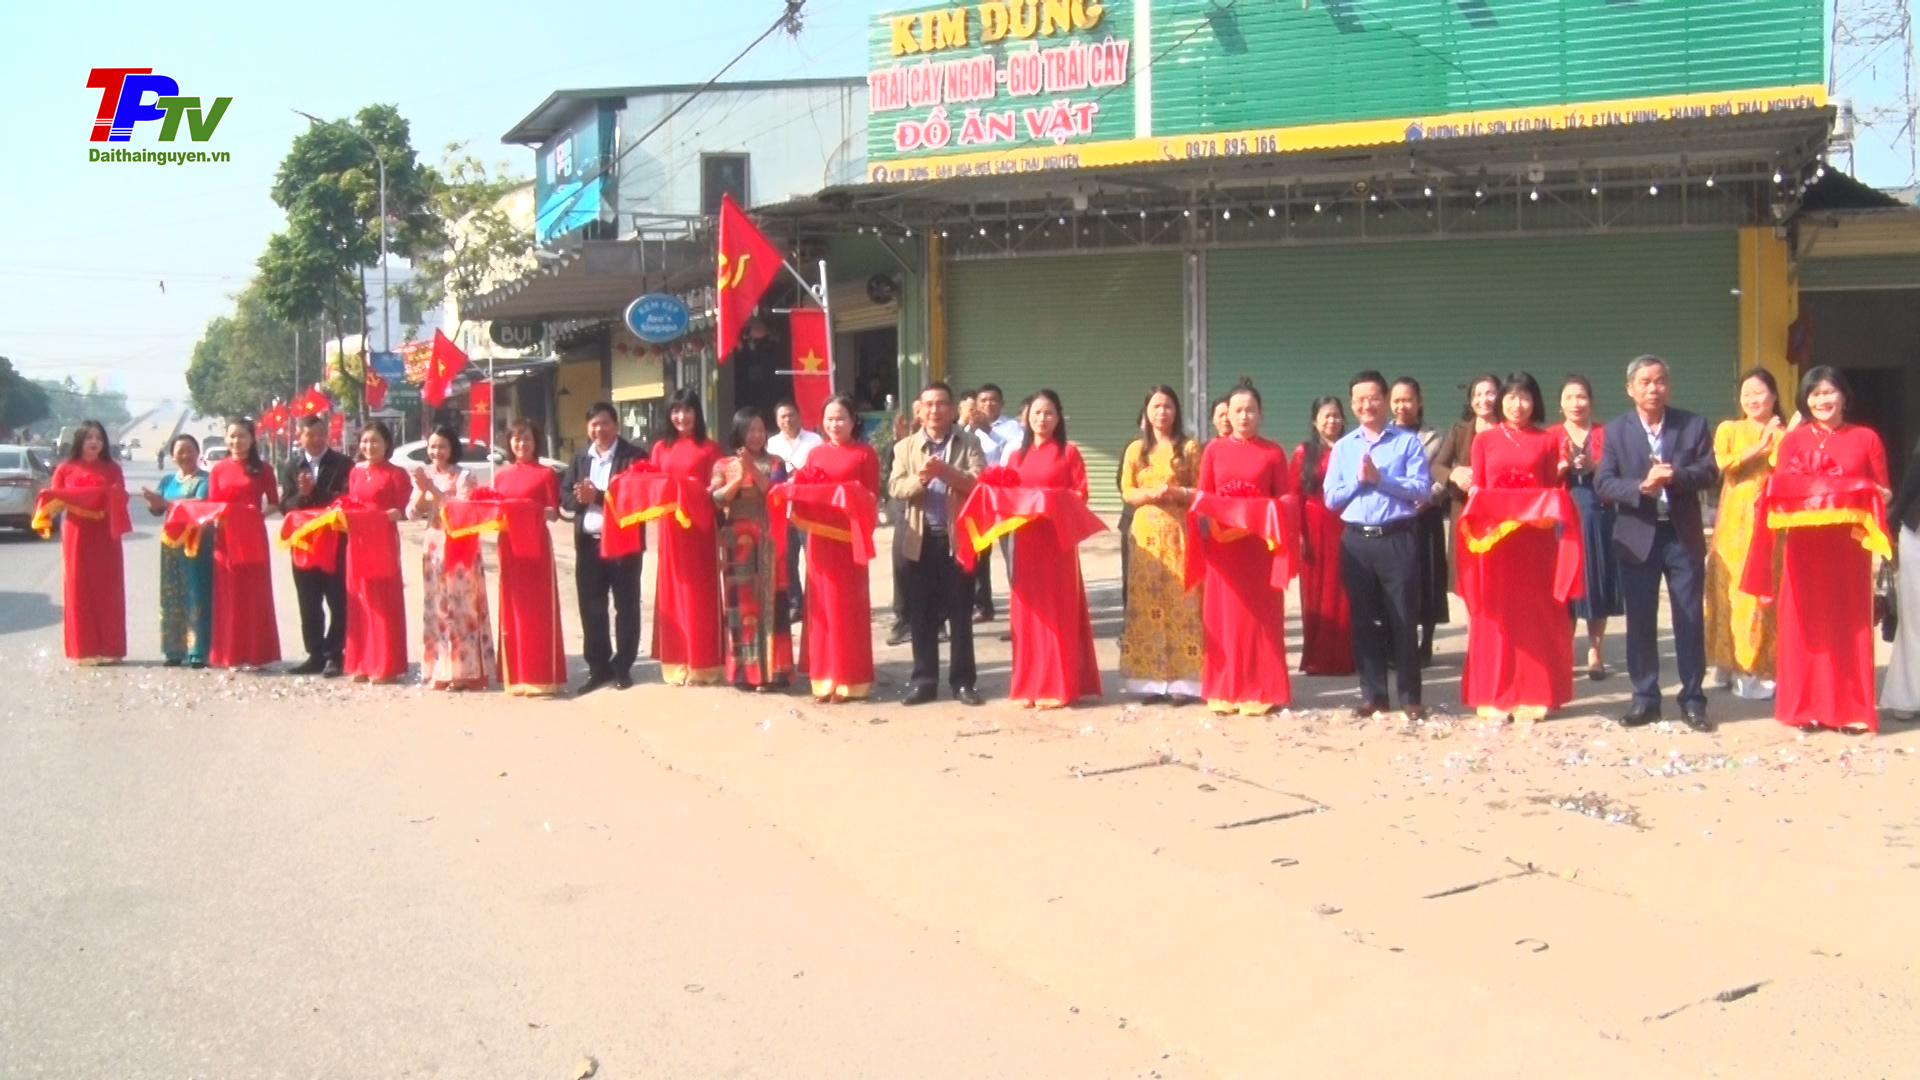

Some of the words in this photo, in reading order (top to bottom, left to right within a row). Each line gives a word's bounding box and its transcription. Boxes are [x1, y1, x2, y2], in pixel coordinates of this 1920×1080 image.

[890, 7, 968, 56] KIM
[868, 63, 907, 111] TRÁI
[908, 58, 944, 107] CÂY
[945, 55, 995, 102] NGON
[1042, 40, 1088, 92] TRÁI
[1089, 35, 1129, 86] CÂY
[895, 105, 952, 151] ĐỒ
[957, 108, 1016, 146] ĂN
[1023, 98, 1099, 146] VẶT
[1185, 139, 1217, 158] 0978
[1254, 134, 1277, 153] 166
